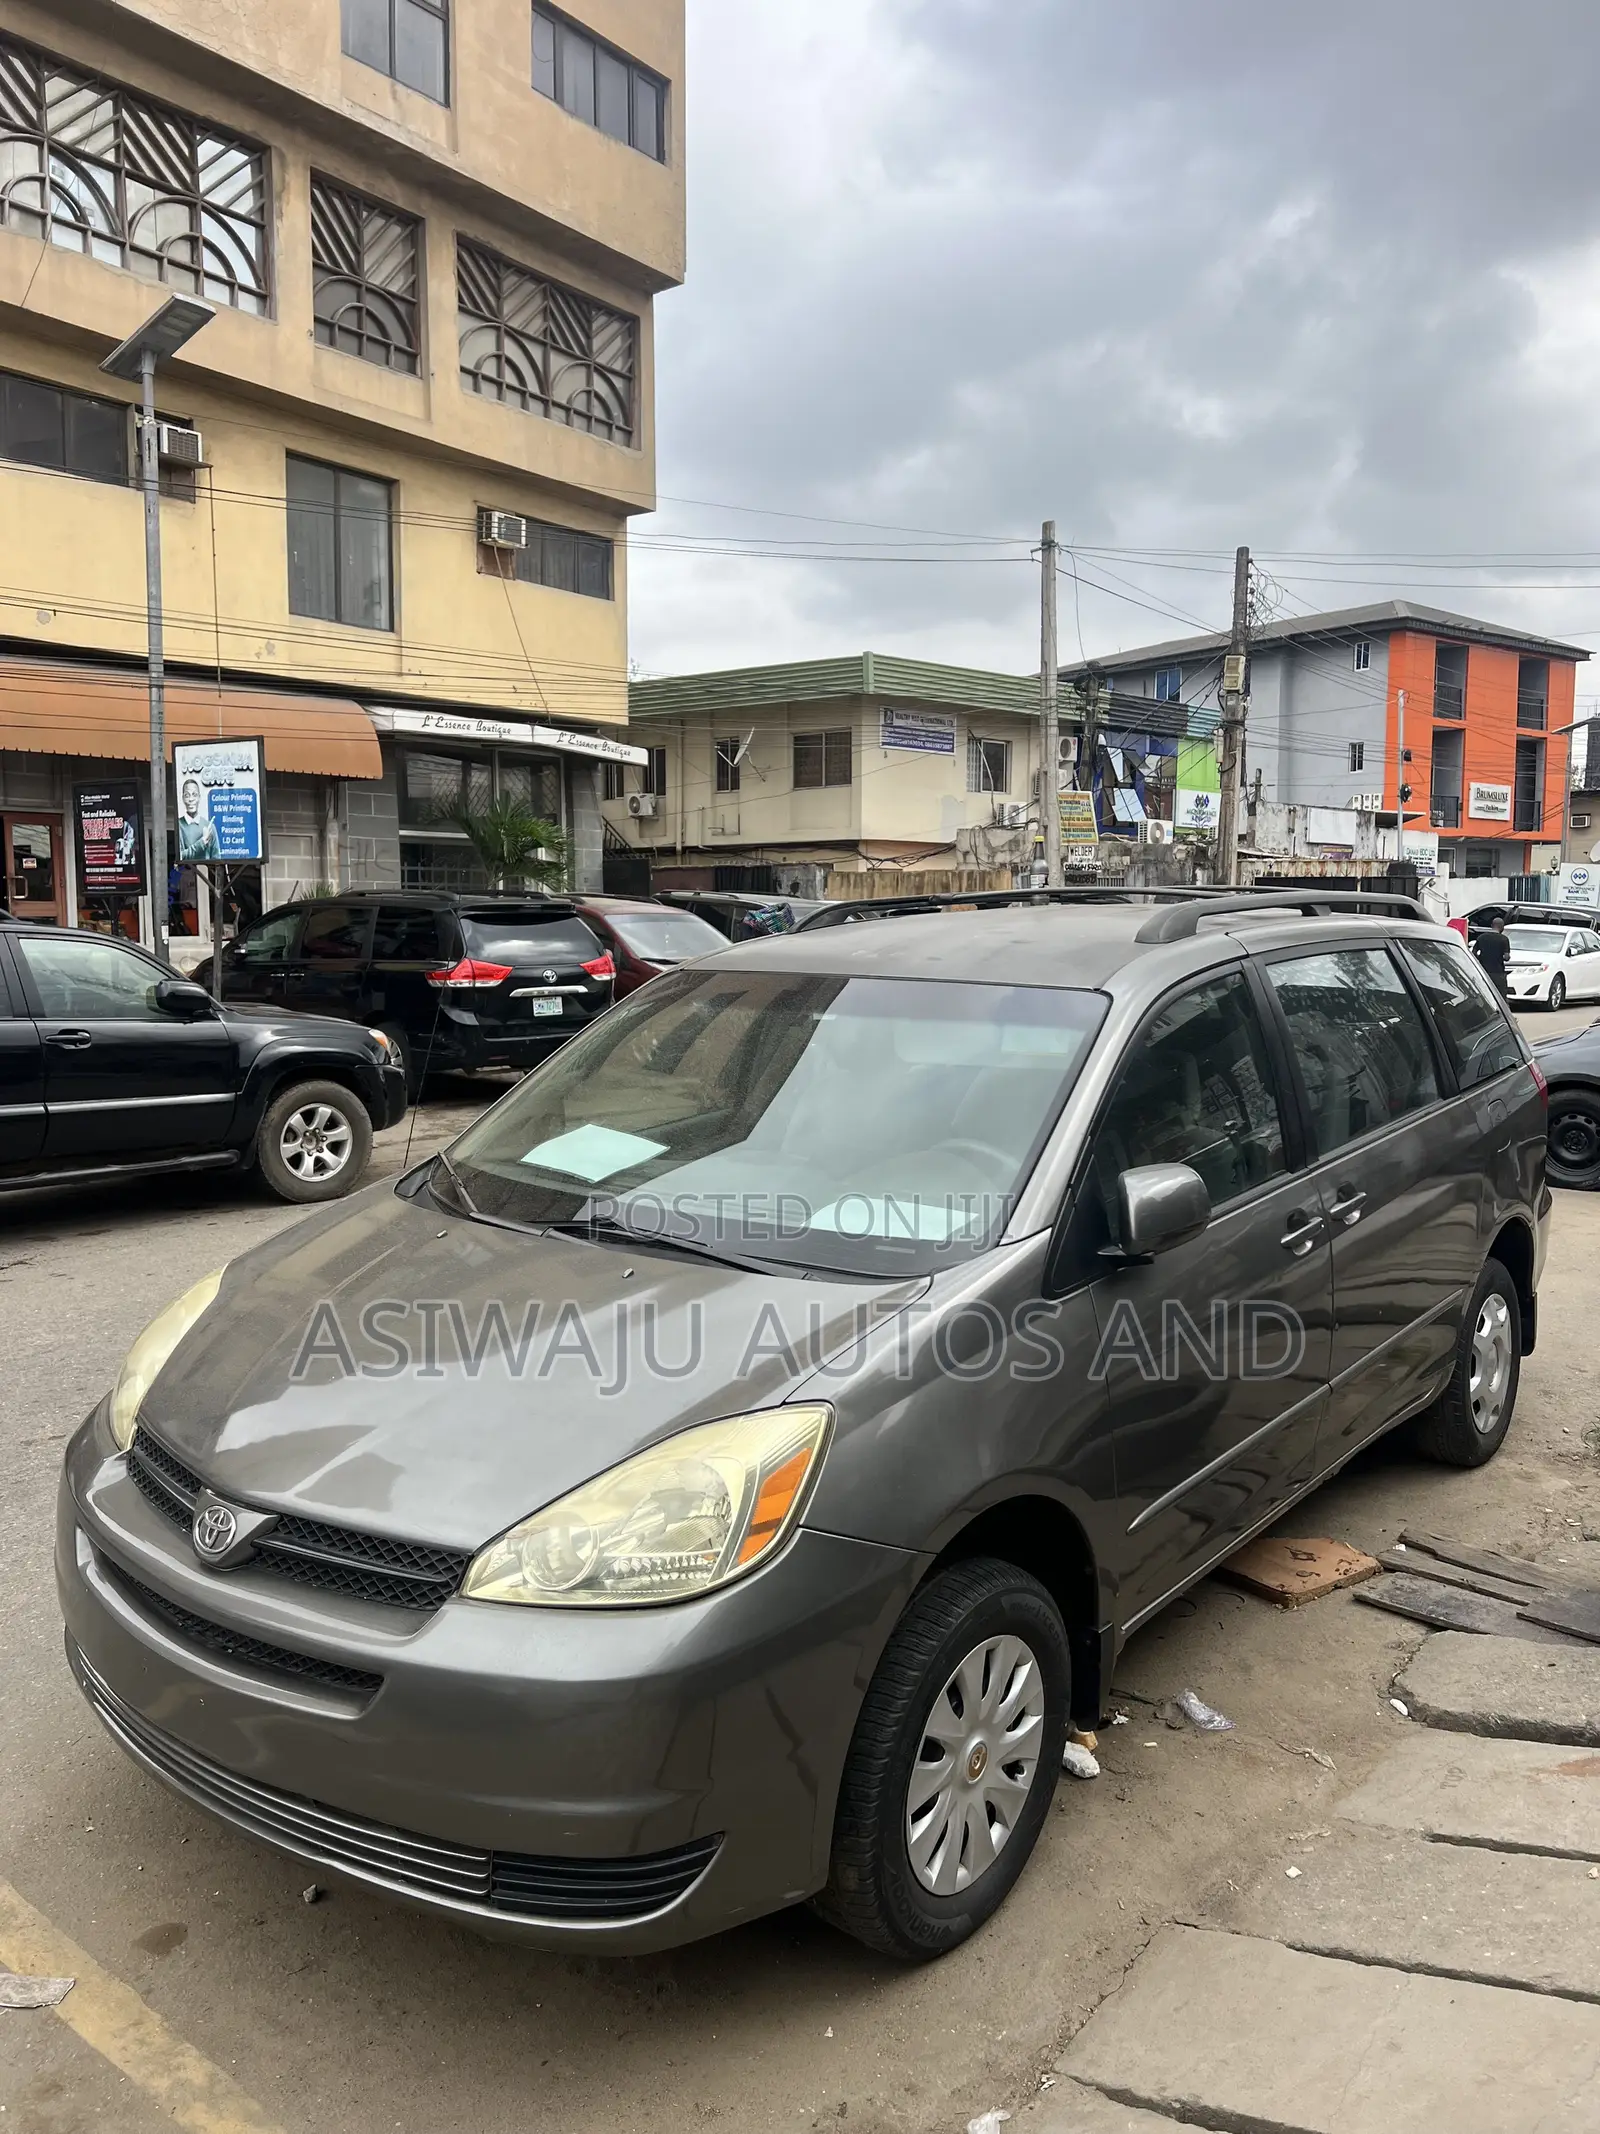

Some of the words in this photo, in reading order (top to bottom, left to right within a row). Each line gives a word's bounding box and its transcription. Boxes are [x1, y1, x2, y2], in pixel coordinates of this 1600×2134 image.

[435, 717, 471, 731] Essence
[475, 720, 512, 739] Boutique
[568, 733, 598, 750] Essence
[601, 741, 632, 759] Boutique
[211, 794, 230, 802] Colour
[231, 793, 254, 803] Printing
[99, 809, 117, 817] Reliable
[213, 805, 229, 813] B&W
[229, 804, 252, 814] Printing
[222, 815, 244, 824] Binding
[221, 826, 246, 835] Passport
[231, 836, 245, 844] Card
[219, 847, 250, 855] Lamination
[1069, 846, 1093, 857] WELDER
